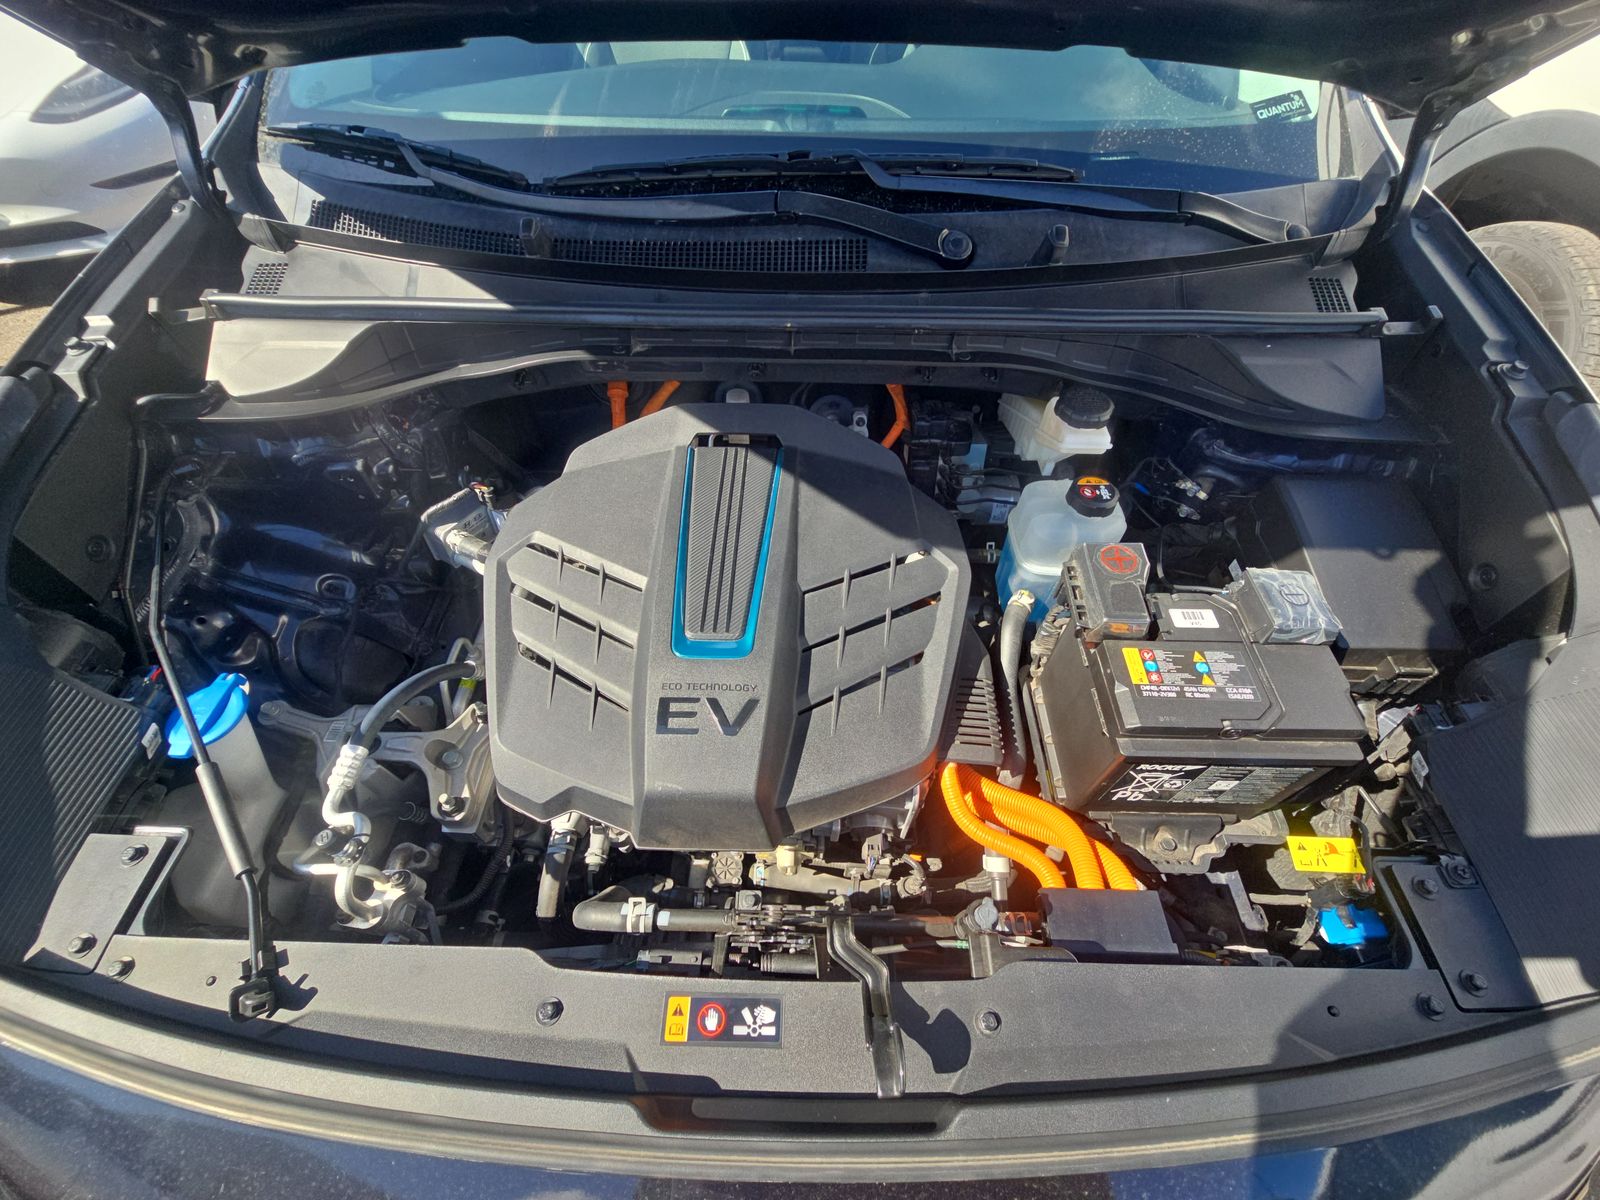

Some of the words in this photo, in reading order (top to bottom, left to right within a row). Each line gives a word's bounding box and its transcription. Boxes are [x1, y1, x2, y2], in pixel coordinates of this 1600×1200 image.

[1257, 100, 1304, 119] QUANTUM
[661, 682, 683, 691] ECO
[686, 682, 758, 692] TECHNOLOGY
[656, 697, 760, 736] EV
[1111, 792, 1144, 801] Pb
